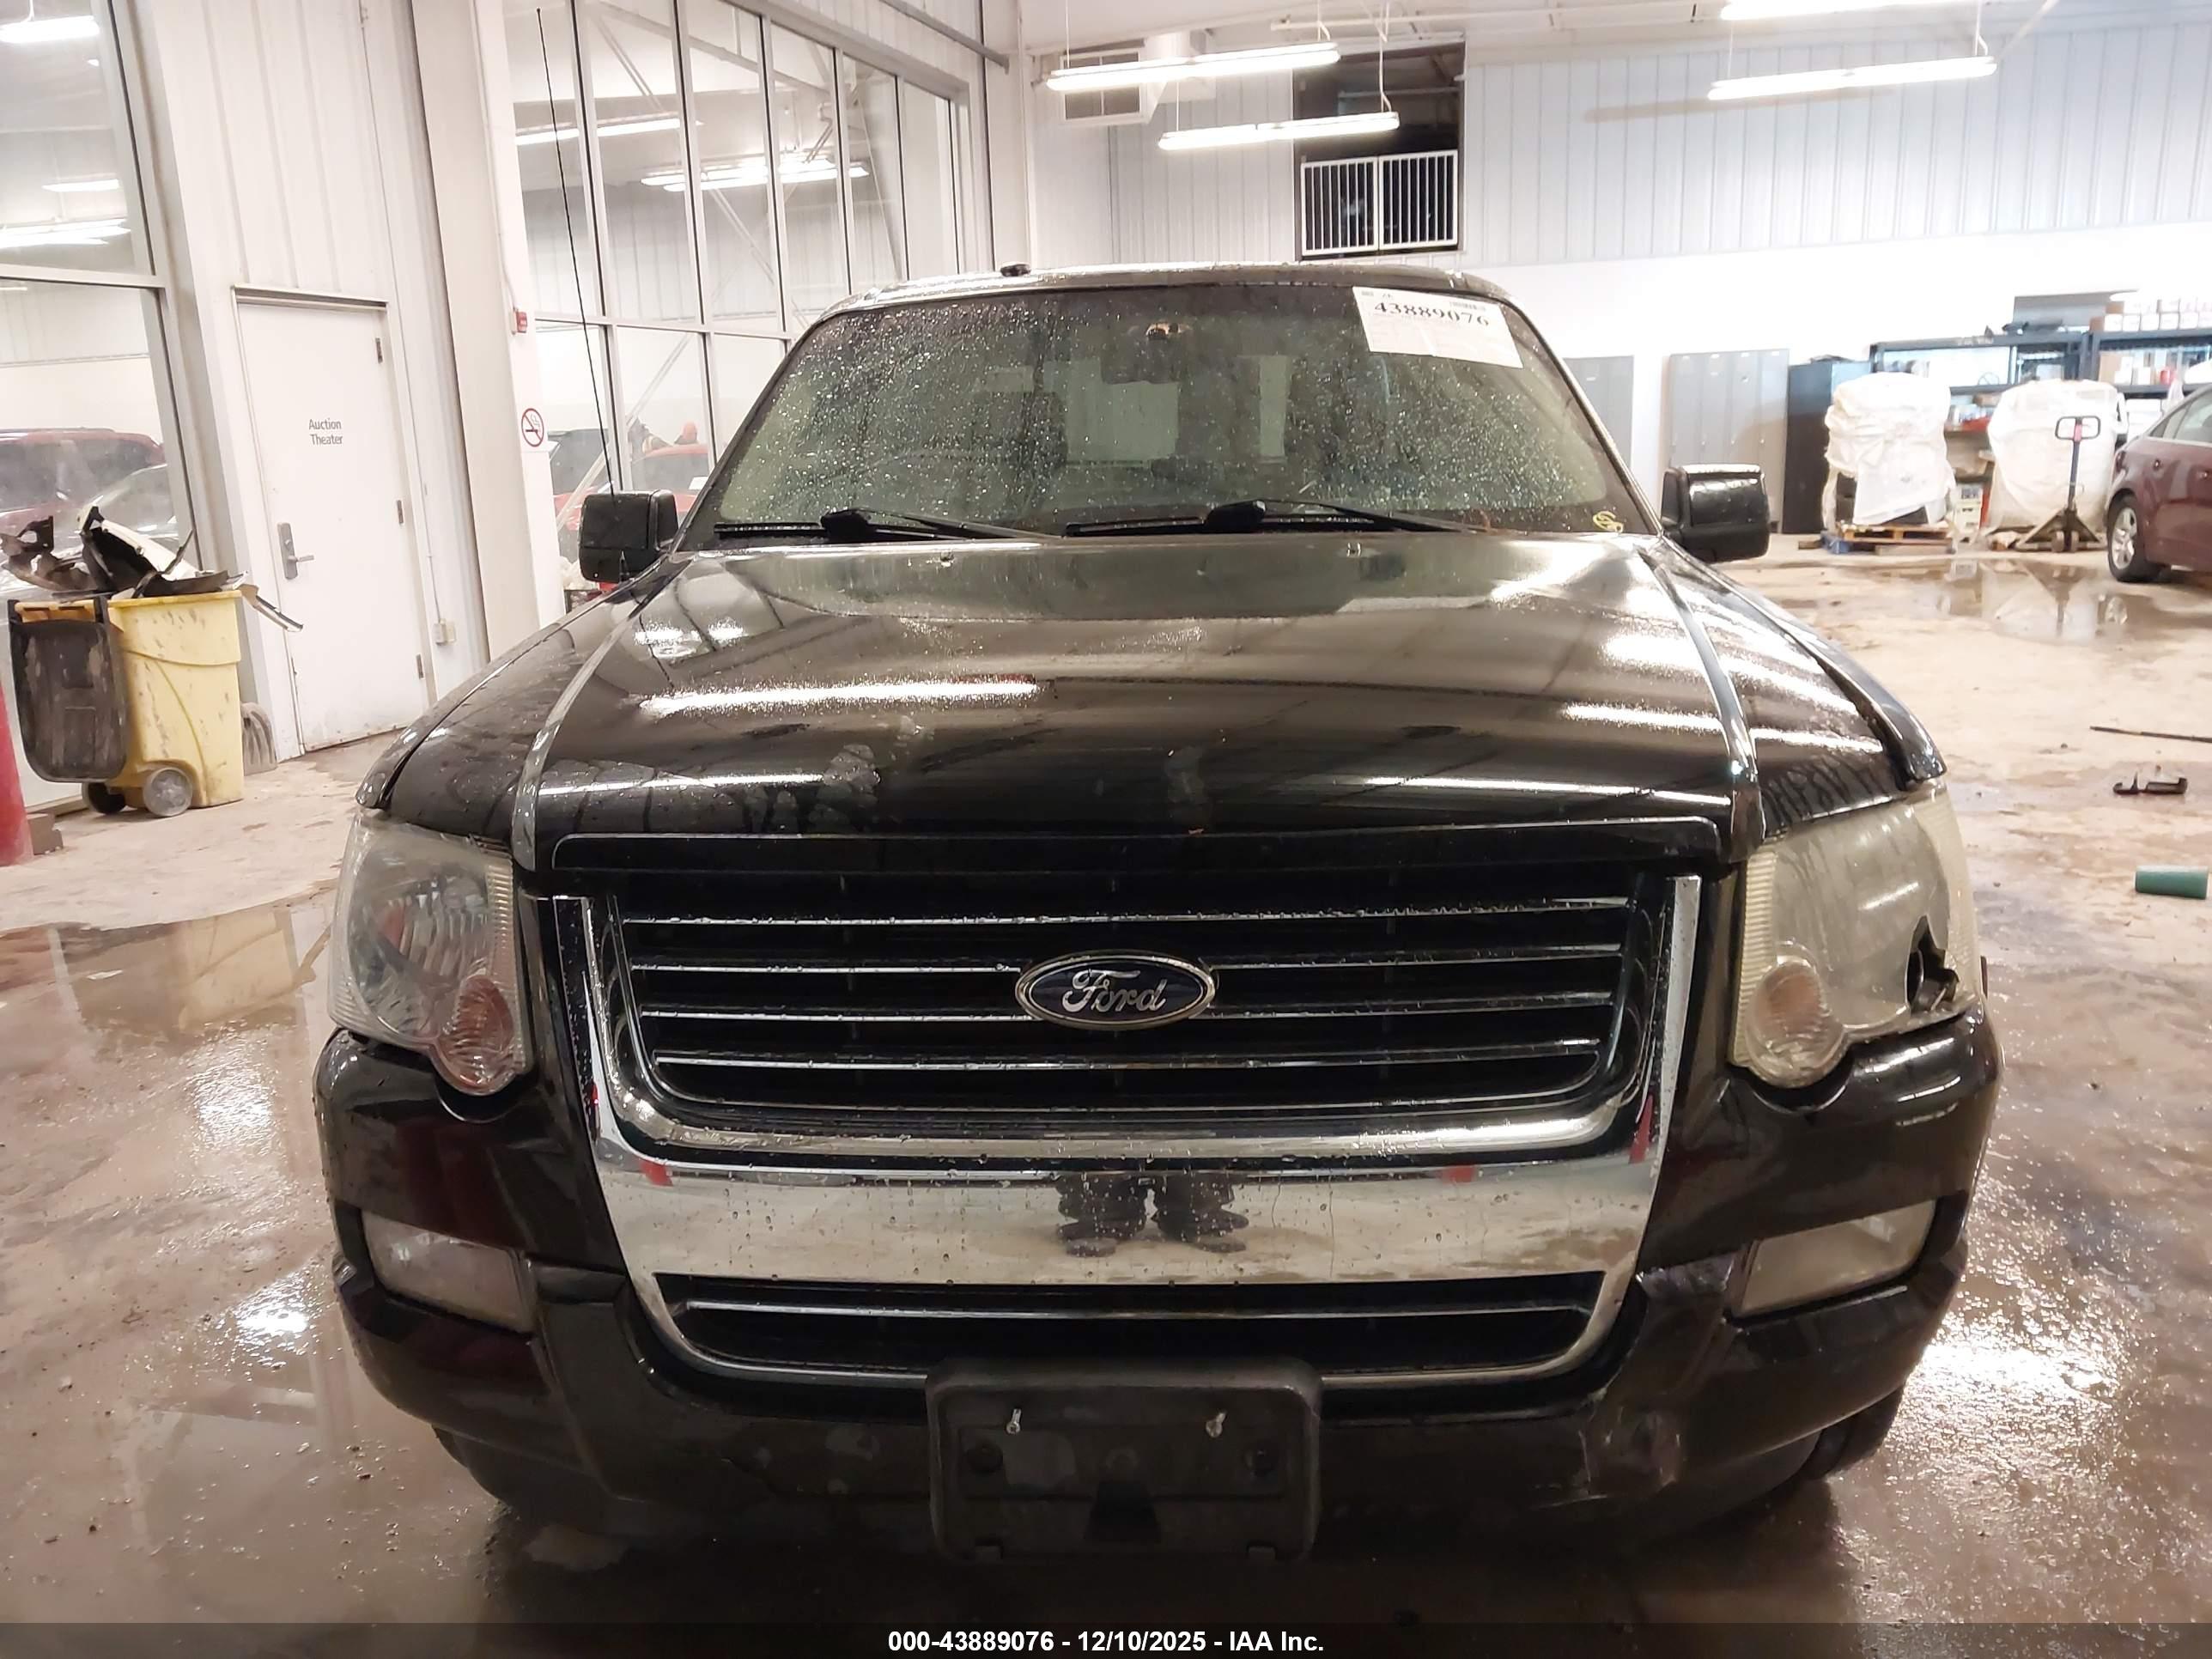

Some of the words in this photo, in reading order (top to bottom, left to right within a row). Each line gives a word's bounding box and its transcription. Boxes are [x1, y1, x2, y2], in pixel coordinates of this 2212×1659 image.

[1375, 301, 1490, 326] 43889076
[309, 417, 342, 430] Auction
[309, 434, 343, 445] Theater
[1061, 968, 1168, 1012] Ford
